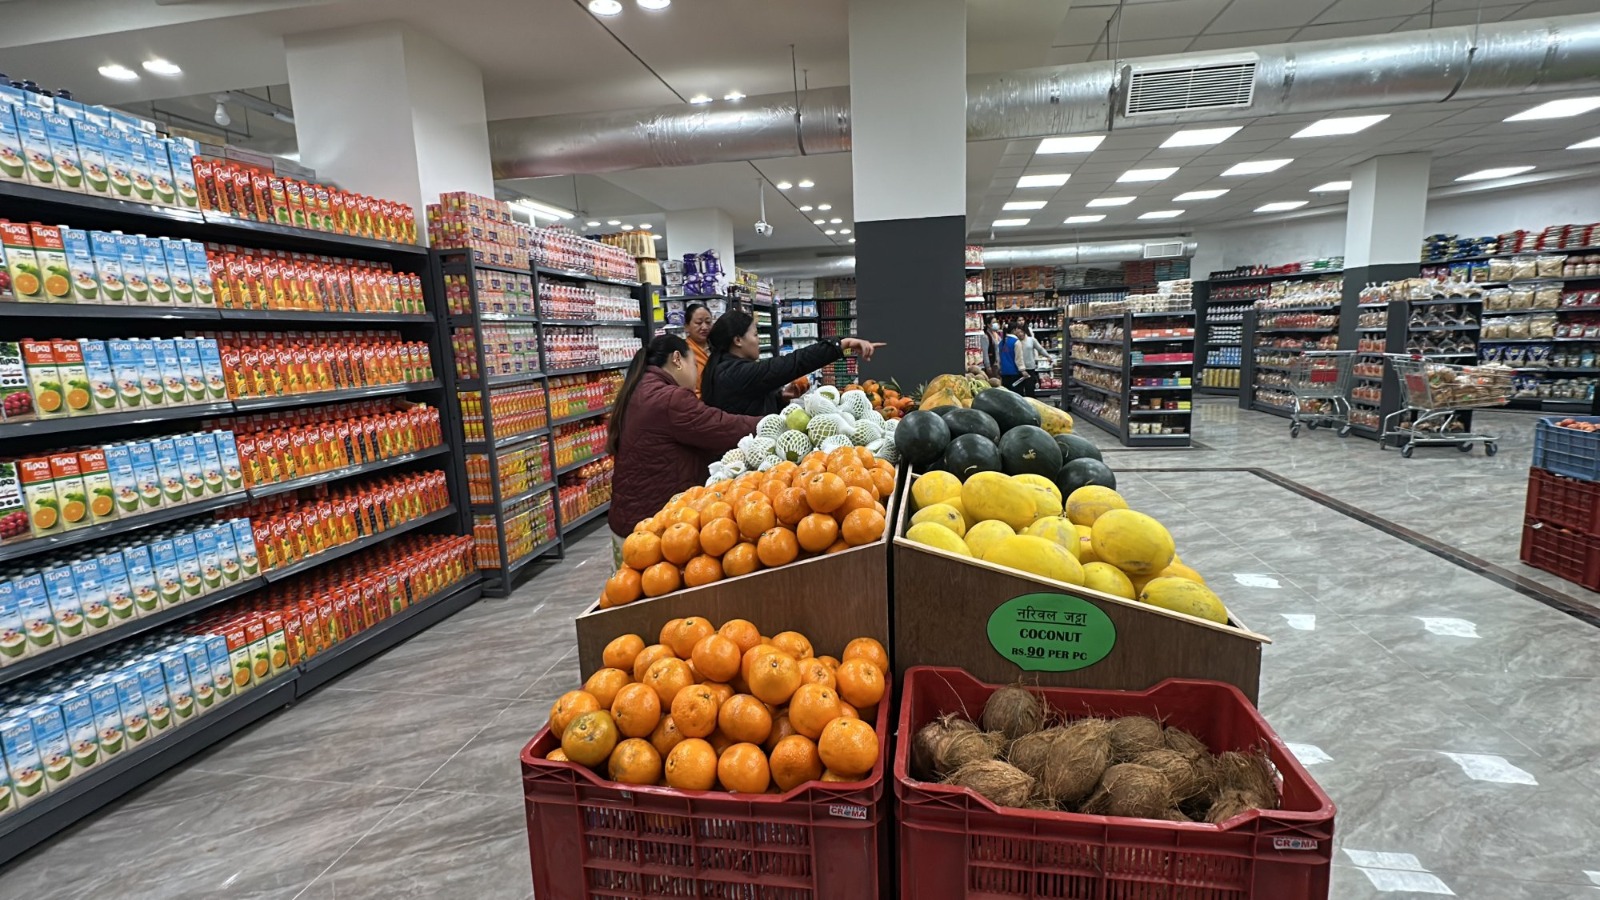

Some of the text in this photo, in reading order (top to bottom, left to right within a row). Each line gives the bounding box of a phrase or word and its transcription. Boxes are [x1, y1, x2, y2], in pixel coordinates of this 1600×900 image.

[1, 223, 27, 234] Tipco
[32, 226, 58, 237] Tipco
[25, 344, 50, 353] Tipco
[53, 344, 78, 353] Tipco
[52, 457, 77, 466] Tipco
[81, 453, 104, 462] Tipco
[22, 461, 48, 471] Tipco
[1020, 628, 1082, 643] COCONUT
[1048, 649, 1069, 660] PER
[1073, 651, 1087, 661] PC
[1275, 839, 1317, 849] CROMA
